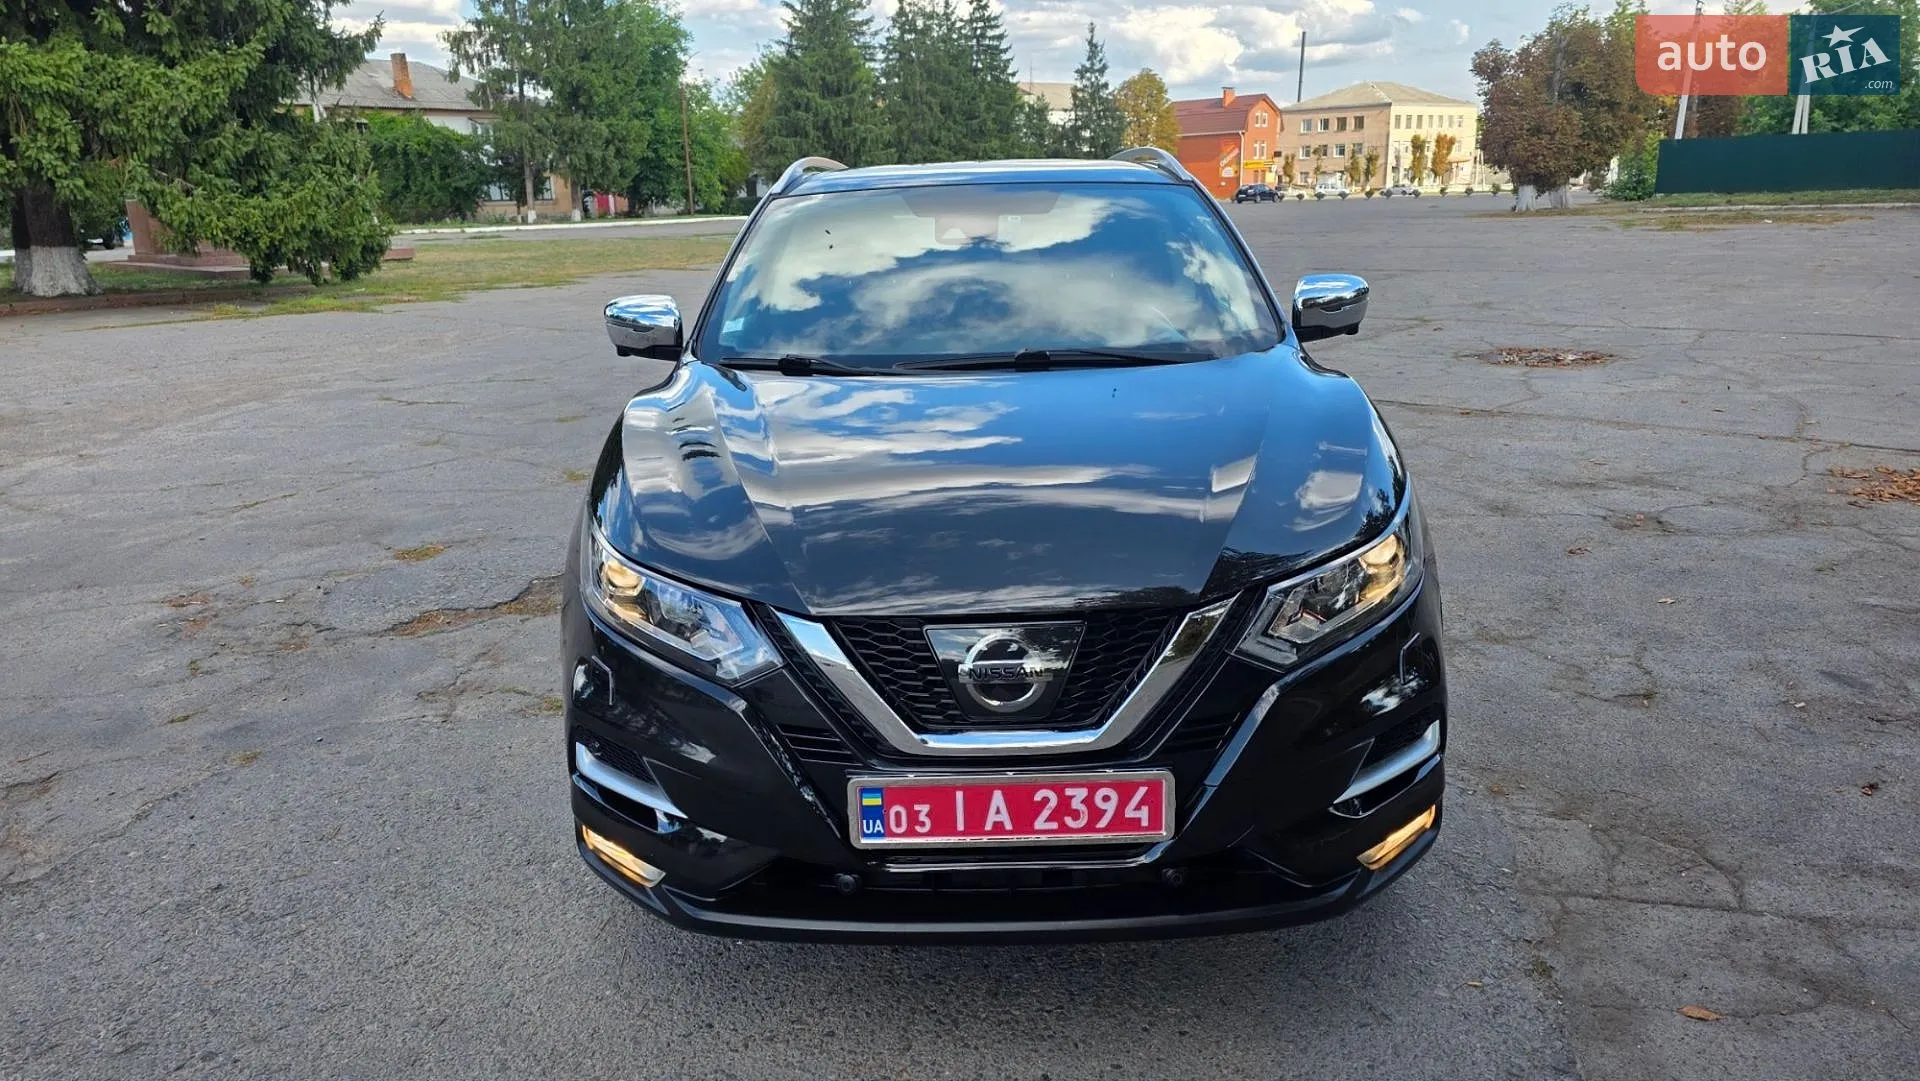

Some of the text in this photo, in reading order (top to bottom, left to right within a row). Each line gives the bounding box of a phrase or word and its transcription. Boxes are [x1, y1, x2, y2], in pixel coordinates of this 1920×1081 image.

[968, 666, 1043, 680] NISSAN
[889, 786, 1149, 834] 03 IA 2394
[862, 819, 884, 834] UA
